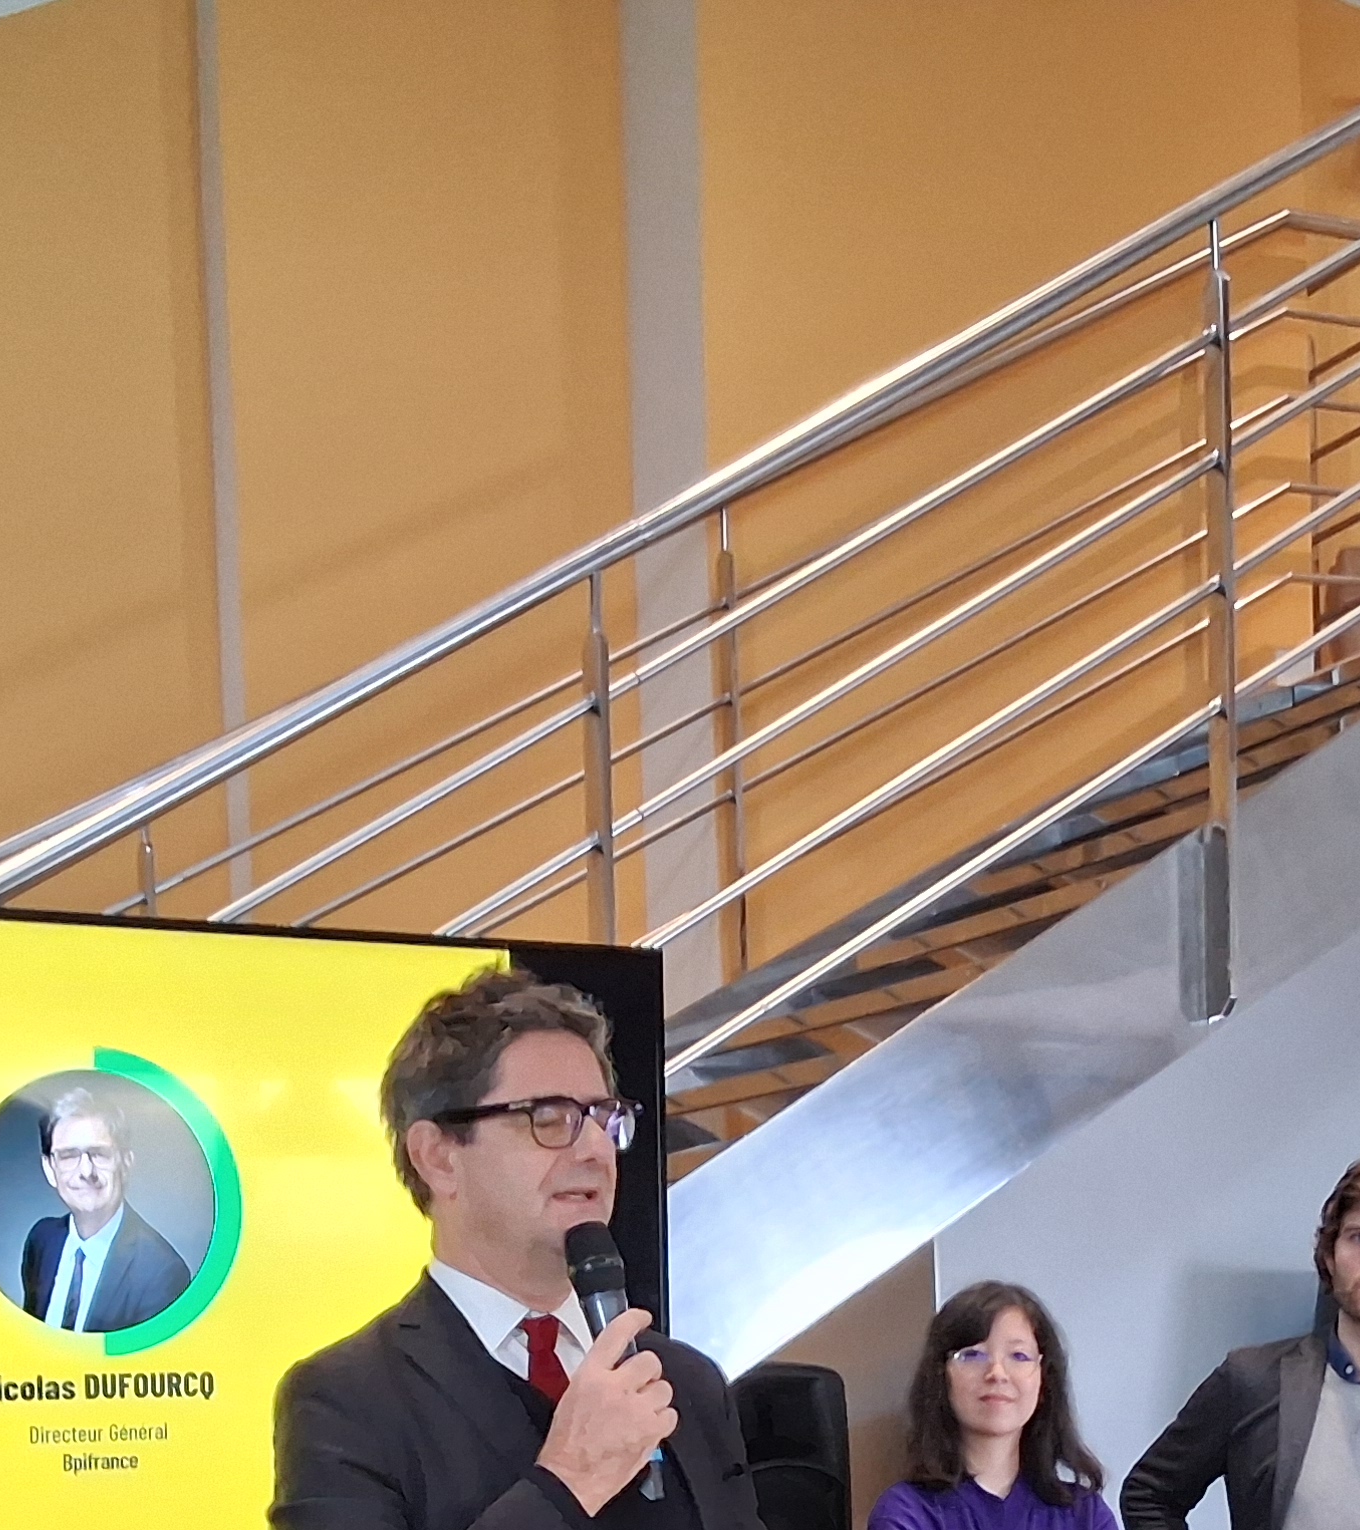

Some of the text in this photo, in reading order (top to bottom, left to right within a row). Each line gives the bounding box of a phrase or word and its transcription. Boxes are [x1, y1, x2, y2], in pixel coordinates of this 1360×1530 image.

[84, 1371, 215, 1400] DUFOURCQ
[29, 1422, 169, 1445] Directeur Général
[62, 1452, 139, 1476] Bpifrance
